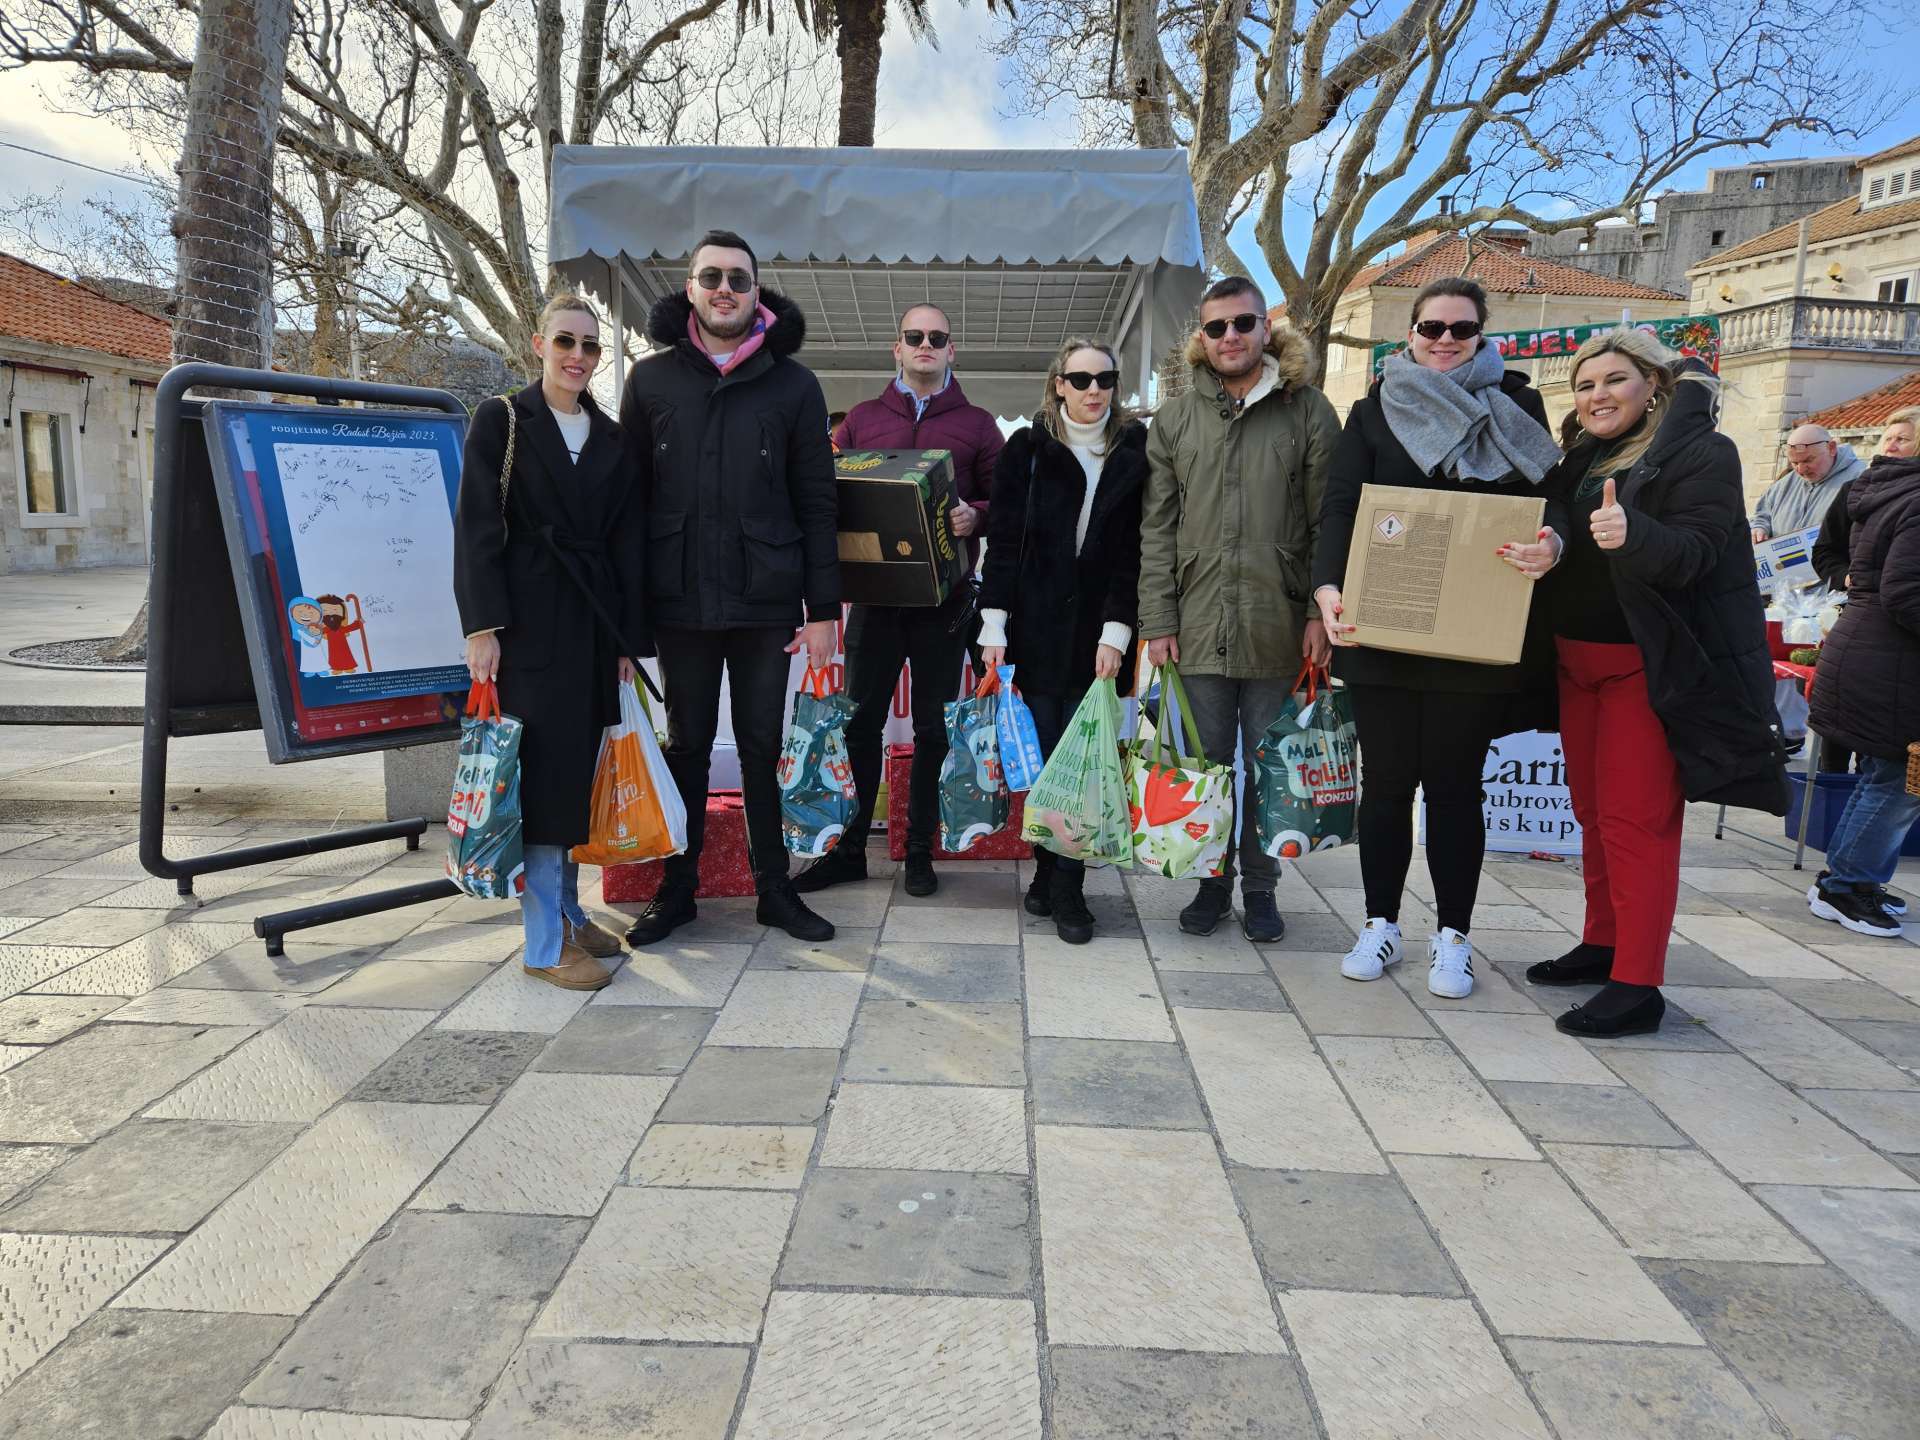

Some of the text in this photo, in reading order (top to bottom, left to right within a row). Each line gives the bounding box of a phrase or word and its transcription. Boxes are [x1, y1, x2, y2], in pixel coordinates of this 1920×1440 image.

[271, 425, 328, 435] PODIJELIMO
[331, 423, 370, 438] Radost
[408, 429, 438, 441] 2023.
[1316, 790, 1355, 805] KONZU
[1485, 811, 1583, 840] iskup
